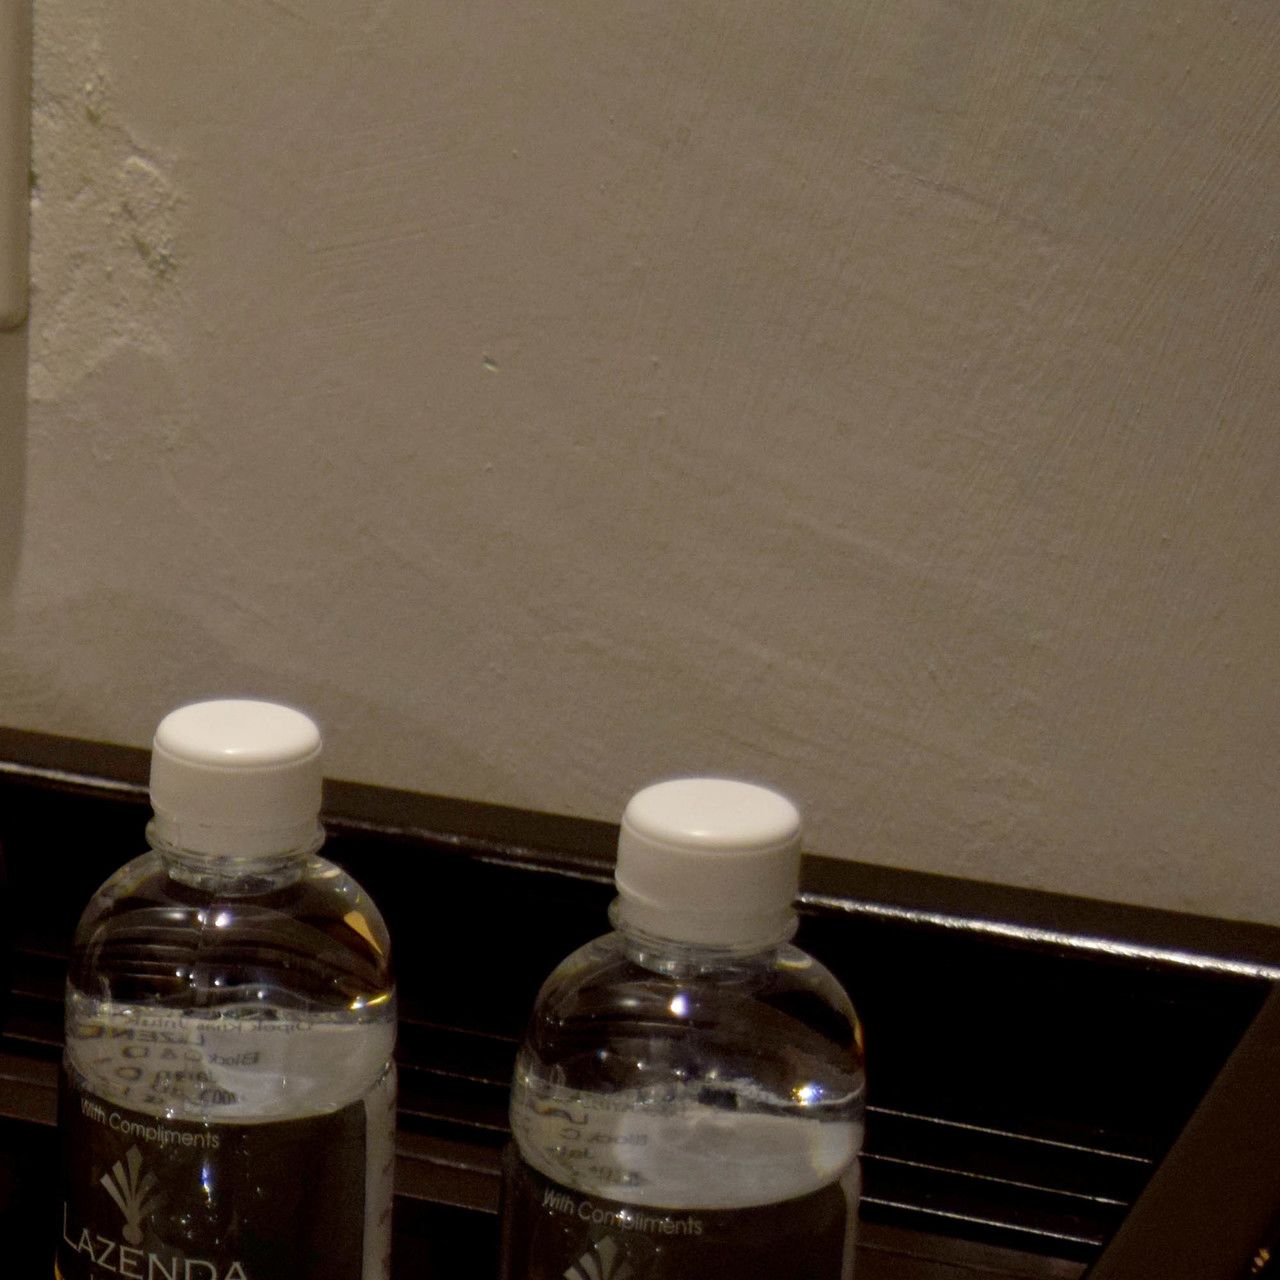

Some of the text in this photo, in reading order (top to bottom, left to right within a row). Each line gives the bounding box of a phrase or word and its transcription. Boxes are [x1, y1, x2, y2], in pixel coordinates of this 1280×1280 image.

[80, 1096, 220, 1149] With Compliments
[543, 1186, 704, 1237] With Compliments
